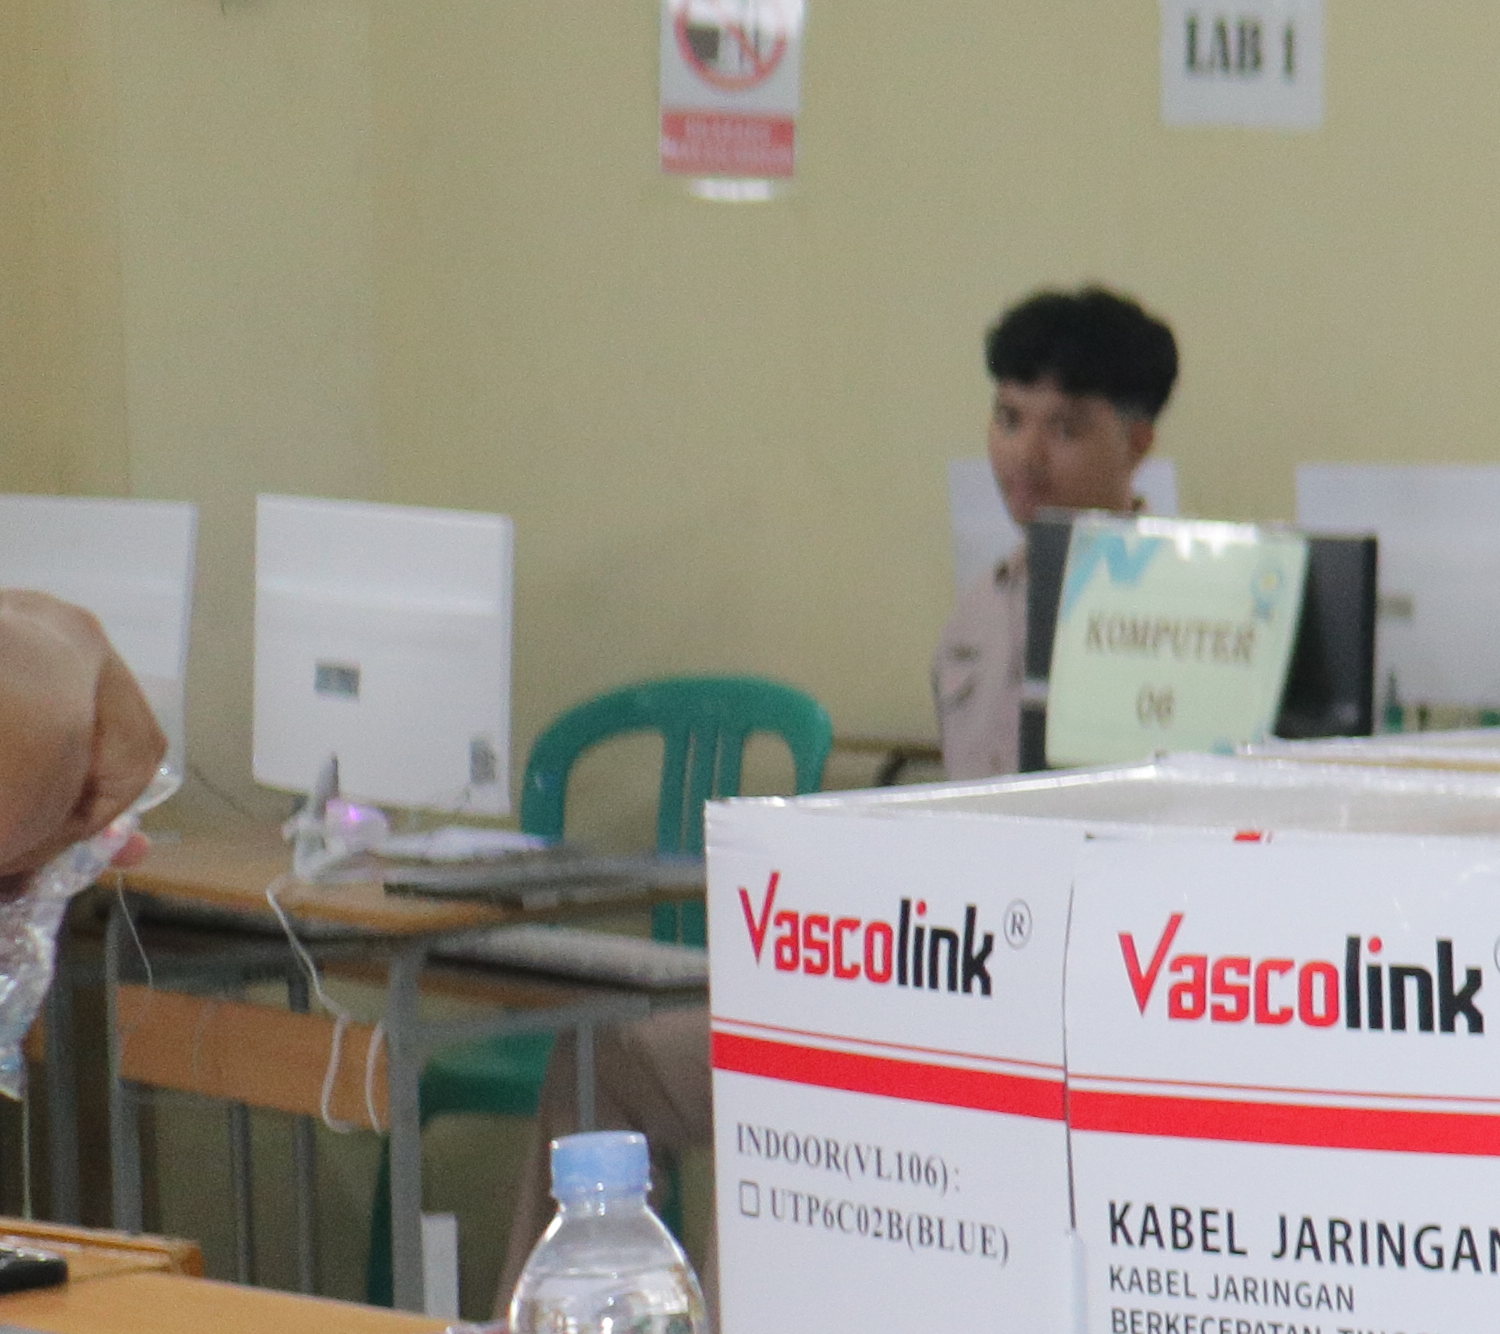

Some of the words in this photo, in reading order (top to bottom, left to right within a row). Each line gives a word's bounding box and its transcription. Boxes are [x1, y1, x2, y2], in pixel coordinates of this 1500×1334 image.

[1184, 12, 1263, 77] LAB
[1088, 612, 1256, 665] KOMPUTER
[738, 870, 994, 999] Vascolink
[1117, 911, 1485, 1036] Vascolink
[770, 1187, 1010, 1268] UTP6C02B(BLUE)
[1107, 1199, 1248, 1257] KABEL
[1108, 1263, 1198, 1300] KABEL
[1207, 1273, 1356, 1313] JARINGAN
